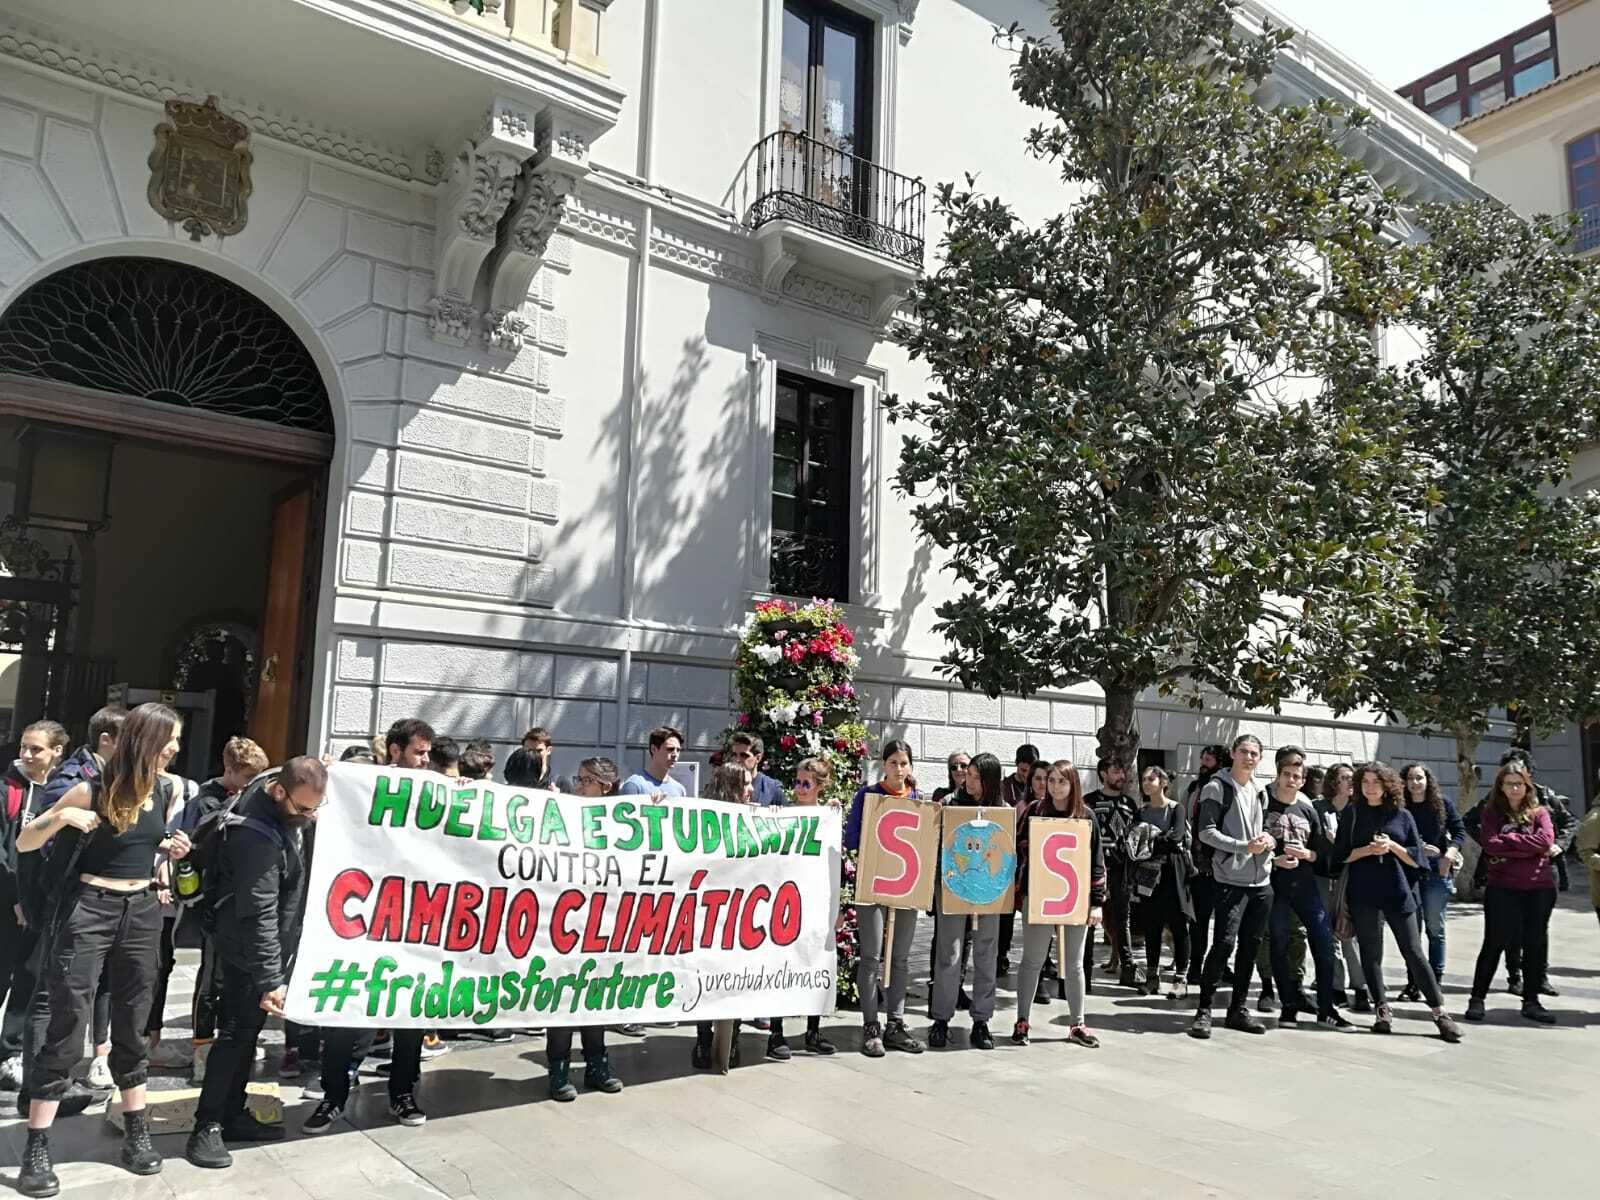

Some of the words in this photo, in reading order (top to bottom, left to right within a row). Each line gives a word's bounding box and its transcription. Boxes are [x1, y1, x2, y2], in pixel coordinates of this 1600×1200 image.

[368, 775, 570, 846] HUELGA
[582, 802, 823, 858] ESTUDIANTIL
[499, 844, 622, 886] CONTRA
[638, 855, 675, 886] EL
[873, 810, 921, 896] S
[1042, 833, 1080, 917] S
[326, 868, 540, 959] CAMBIO
[550, 870, 802, 956] CLIMÁTICO
[308, 957, 676, 1025] #fridaysforfuture
